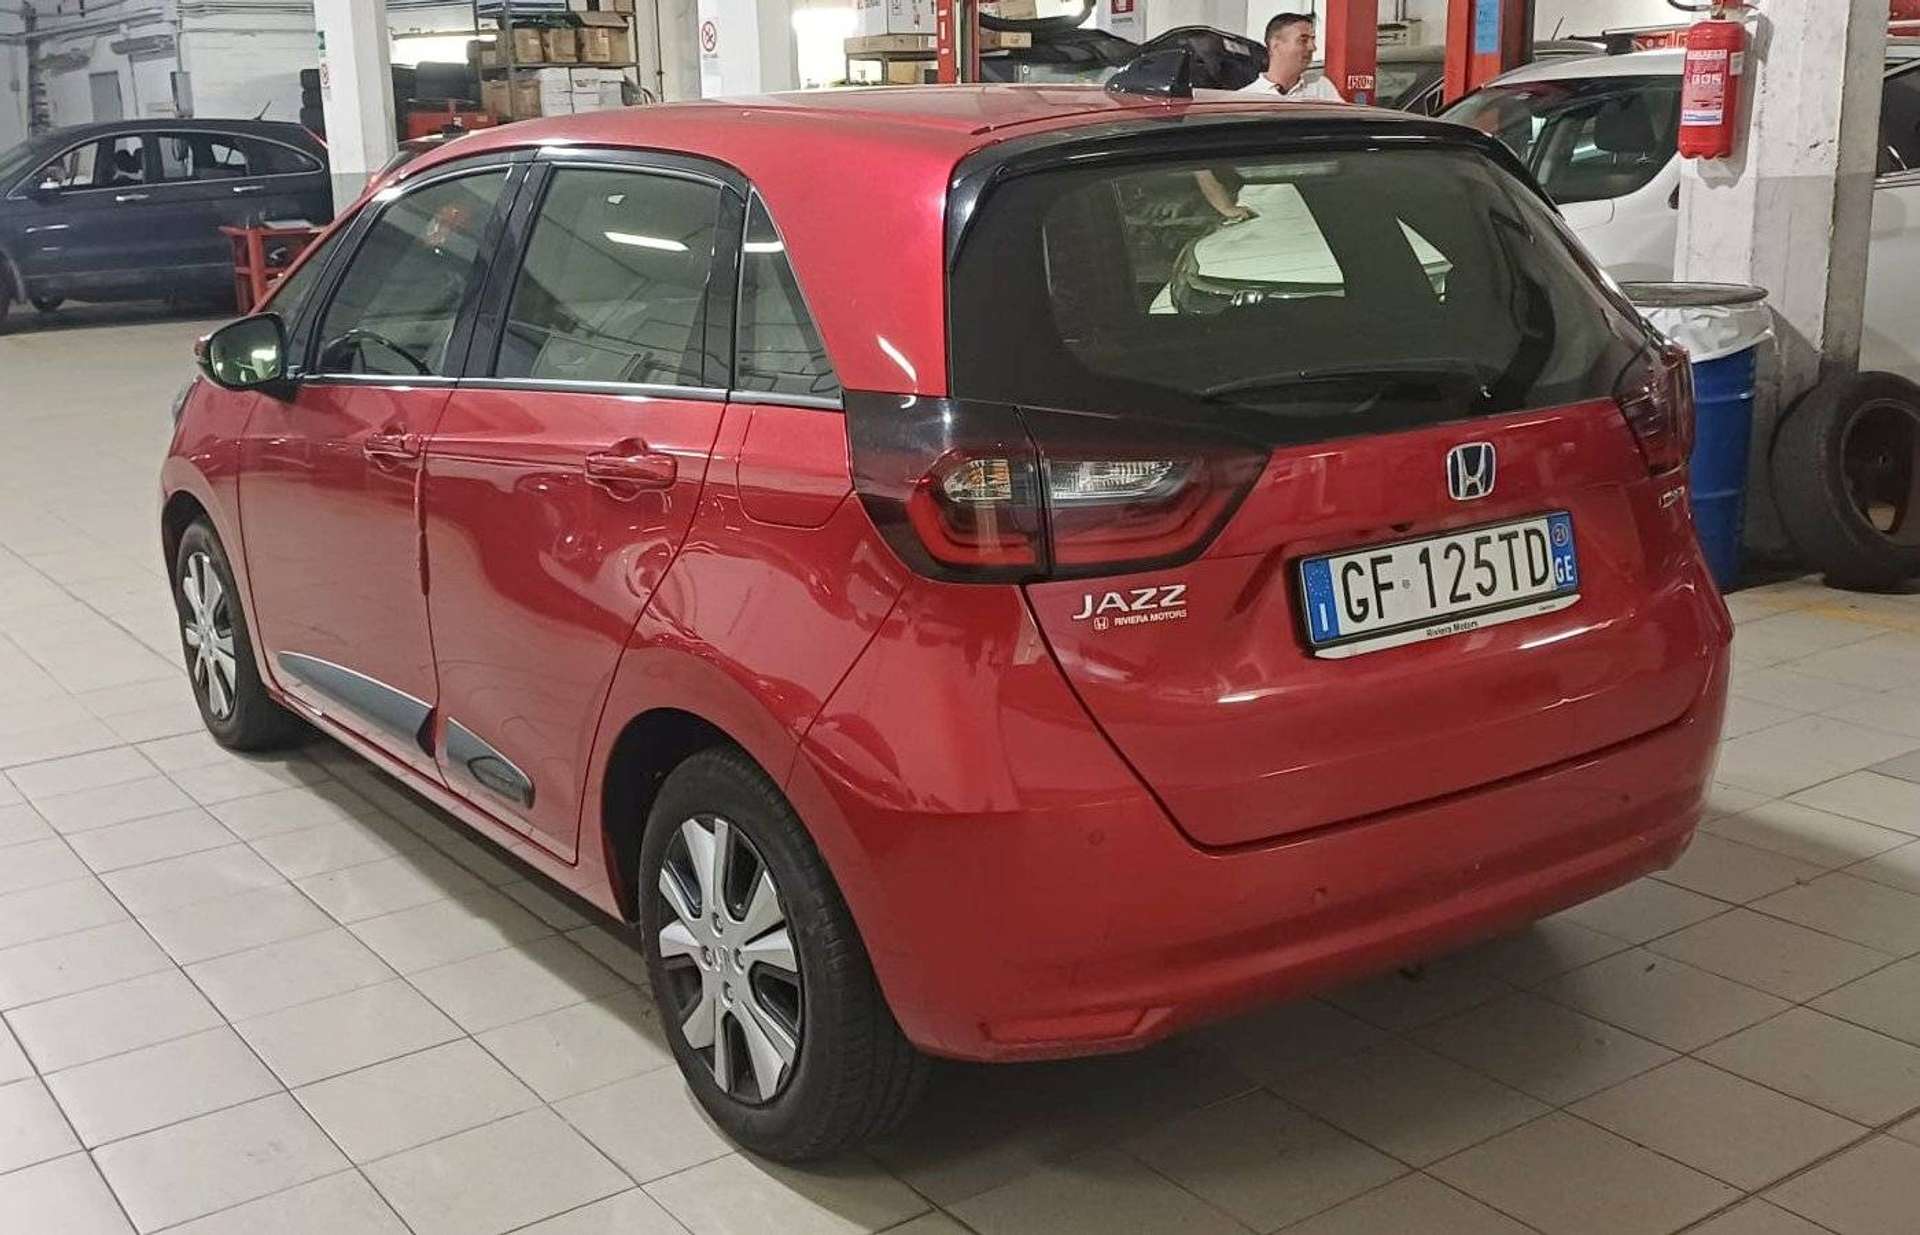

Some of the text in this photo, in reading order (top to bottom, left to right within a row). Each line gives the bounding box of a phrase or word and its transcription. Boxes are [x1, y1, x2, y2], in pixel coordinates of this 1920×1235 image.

[1341, 528, 1550, 623] GF 125TD
[1555, 555, 1574, 584] GE
[1073, 585, 1187, 620] JAZZ
[1114, 614, 1149, 626] RIVIERA
[1150, 609, 1187, 623] MOTORS
[1319, 603, 1328, 632] I
[1453, 620, 1478, 632] Motors
